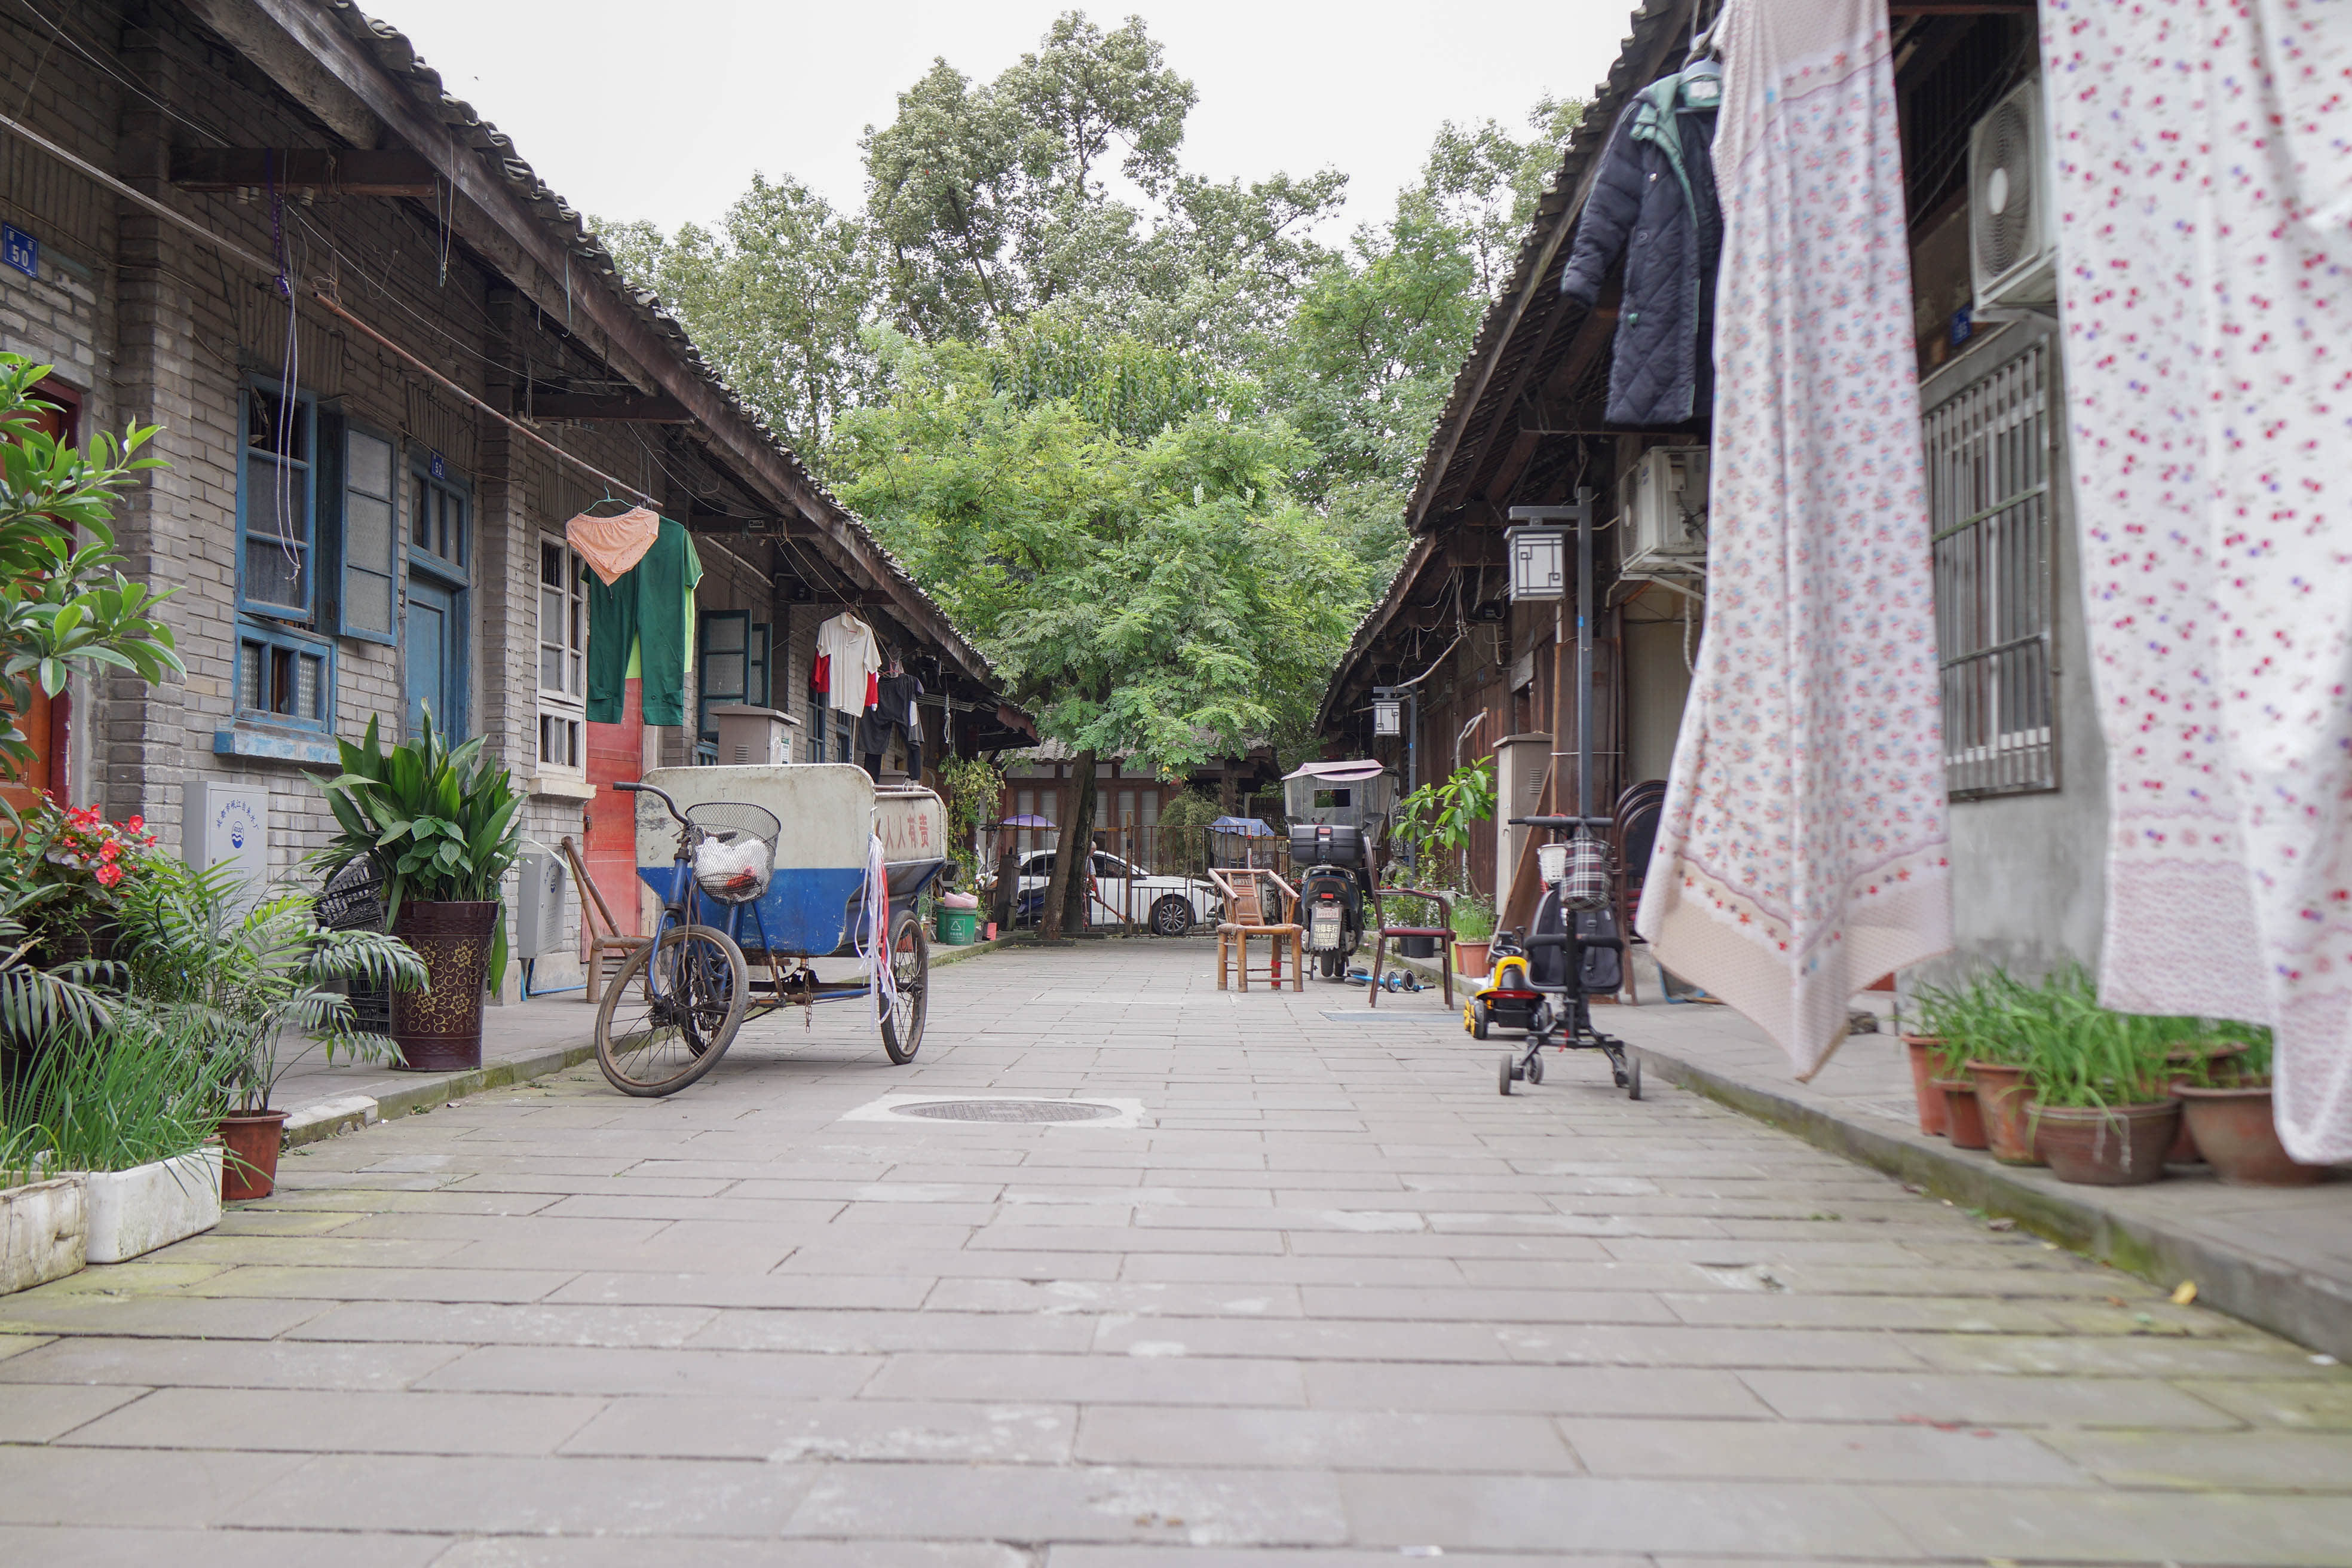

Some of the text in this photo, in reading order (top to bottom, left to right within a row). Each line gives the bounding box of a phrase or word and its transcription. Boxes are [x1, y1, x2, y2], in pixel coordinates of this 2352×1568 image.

[13, 244, 29, 267] 50
[435, 462, 442, 476] 52
[885, 813, 929, 849] 人人有责
[1314, 924, 1339, 932] 刘师车行
